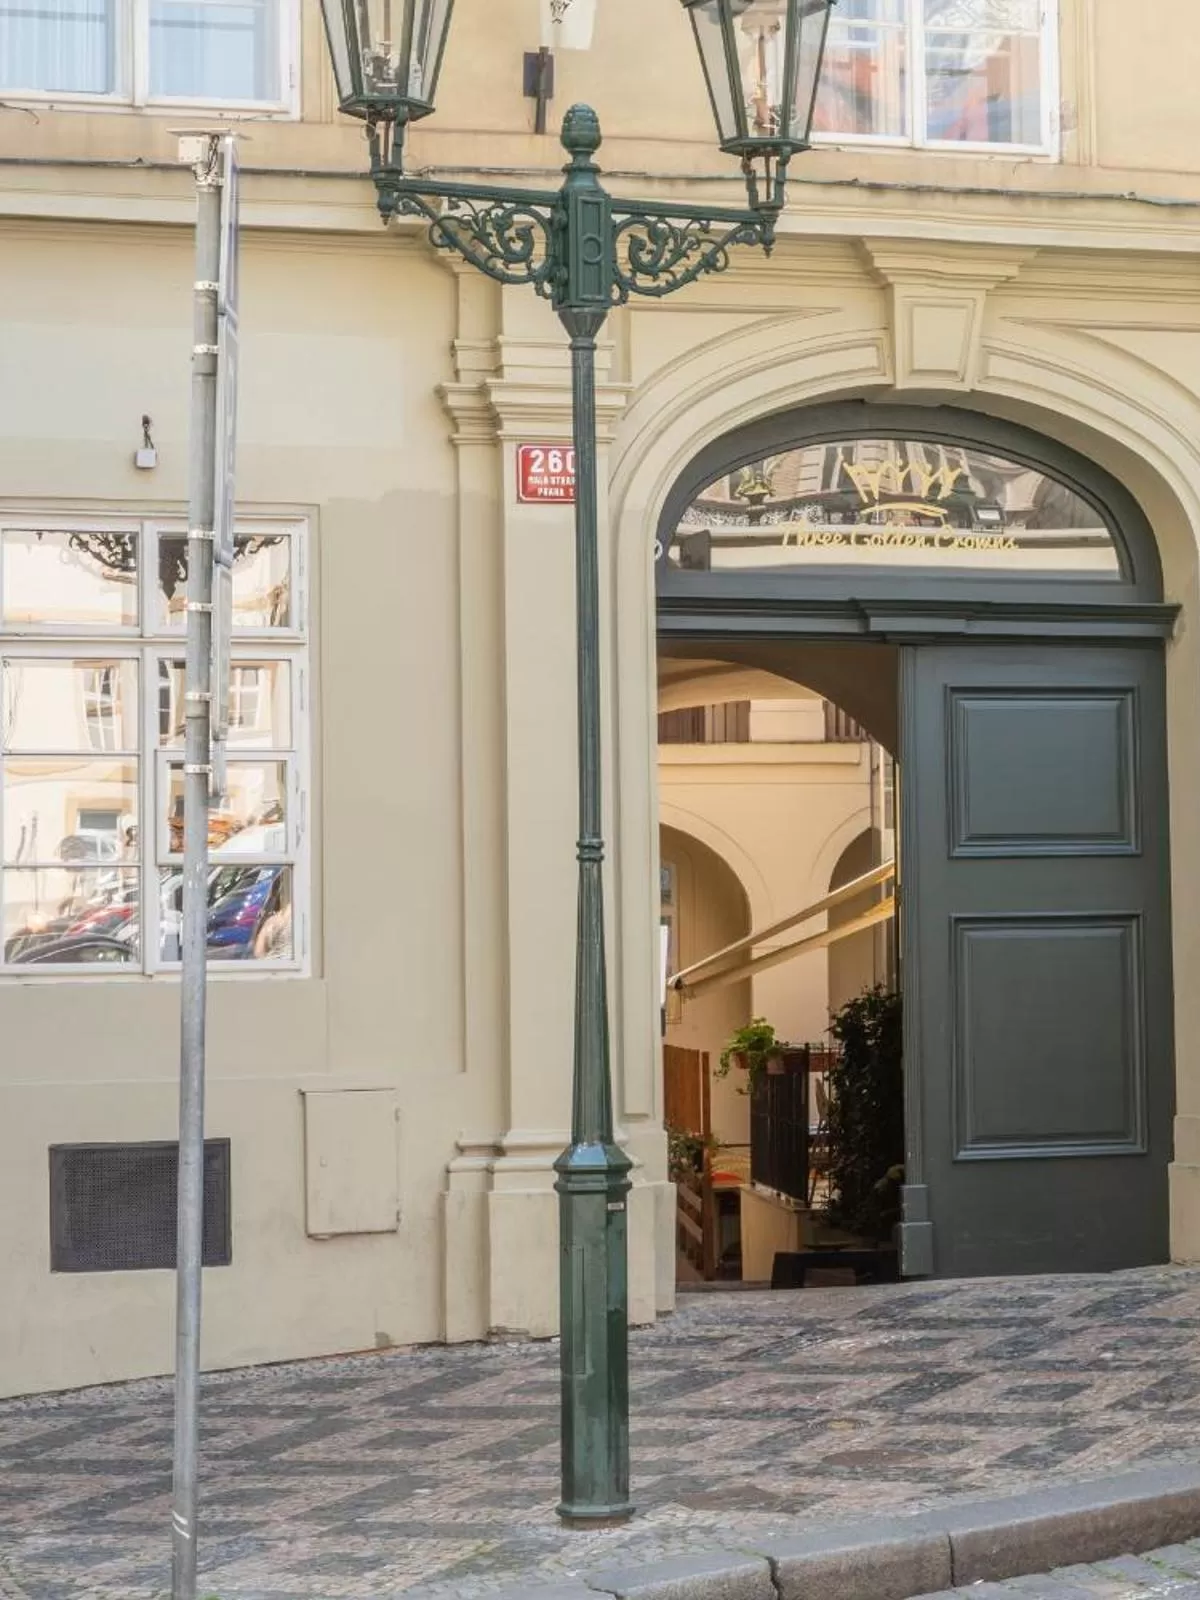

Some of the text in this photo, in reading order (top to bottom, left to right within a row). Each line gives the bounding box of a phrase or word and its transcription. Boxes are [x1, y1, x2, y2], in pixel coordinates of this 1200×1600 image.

[778, 520, 1019, 550] Three Golden Crowns
